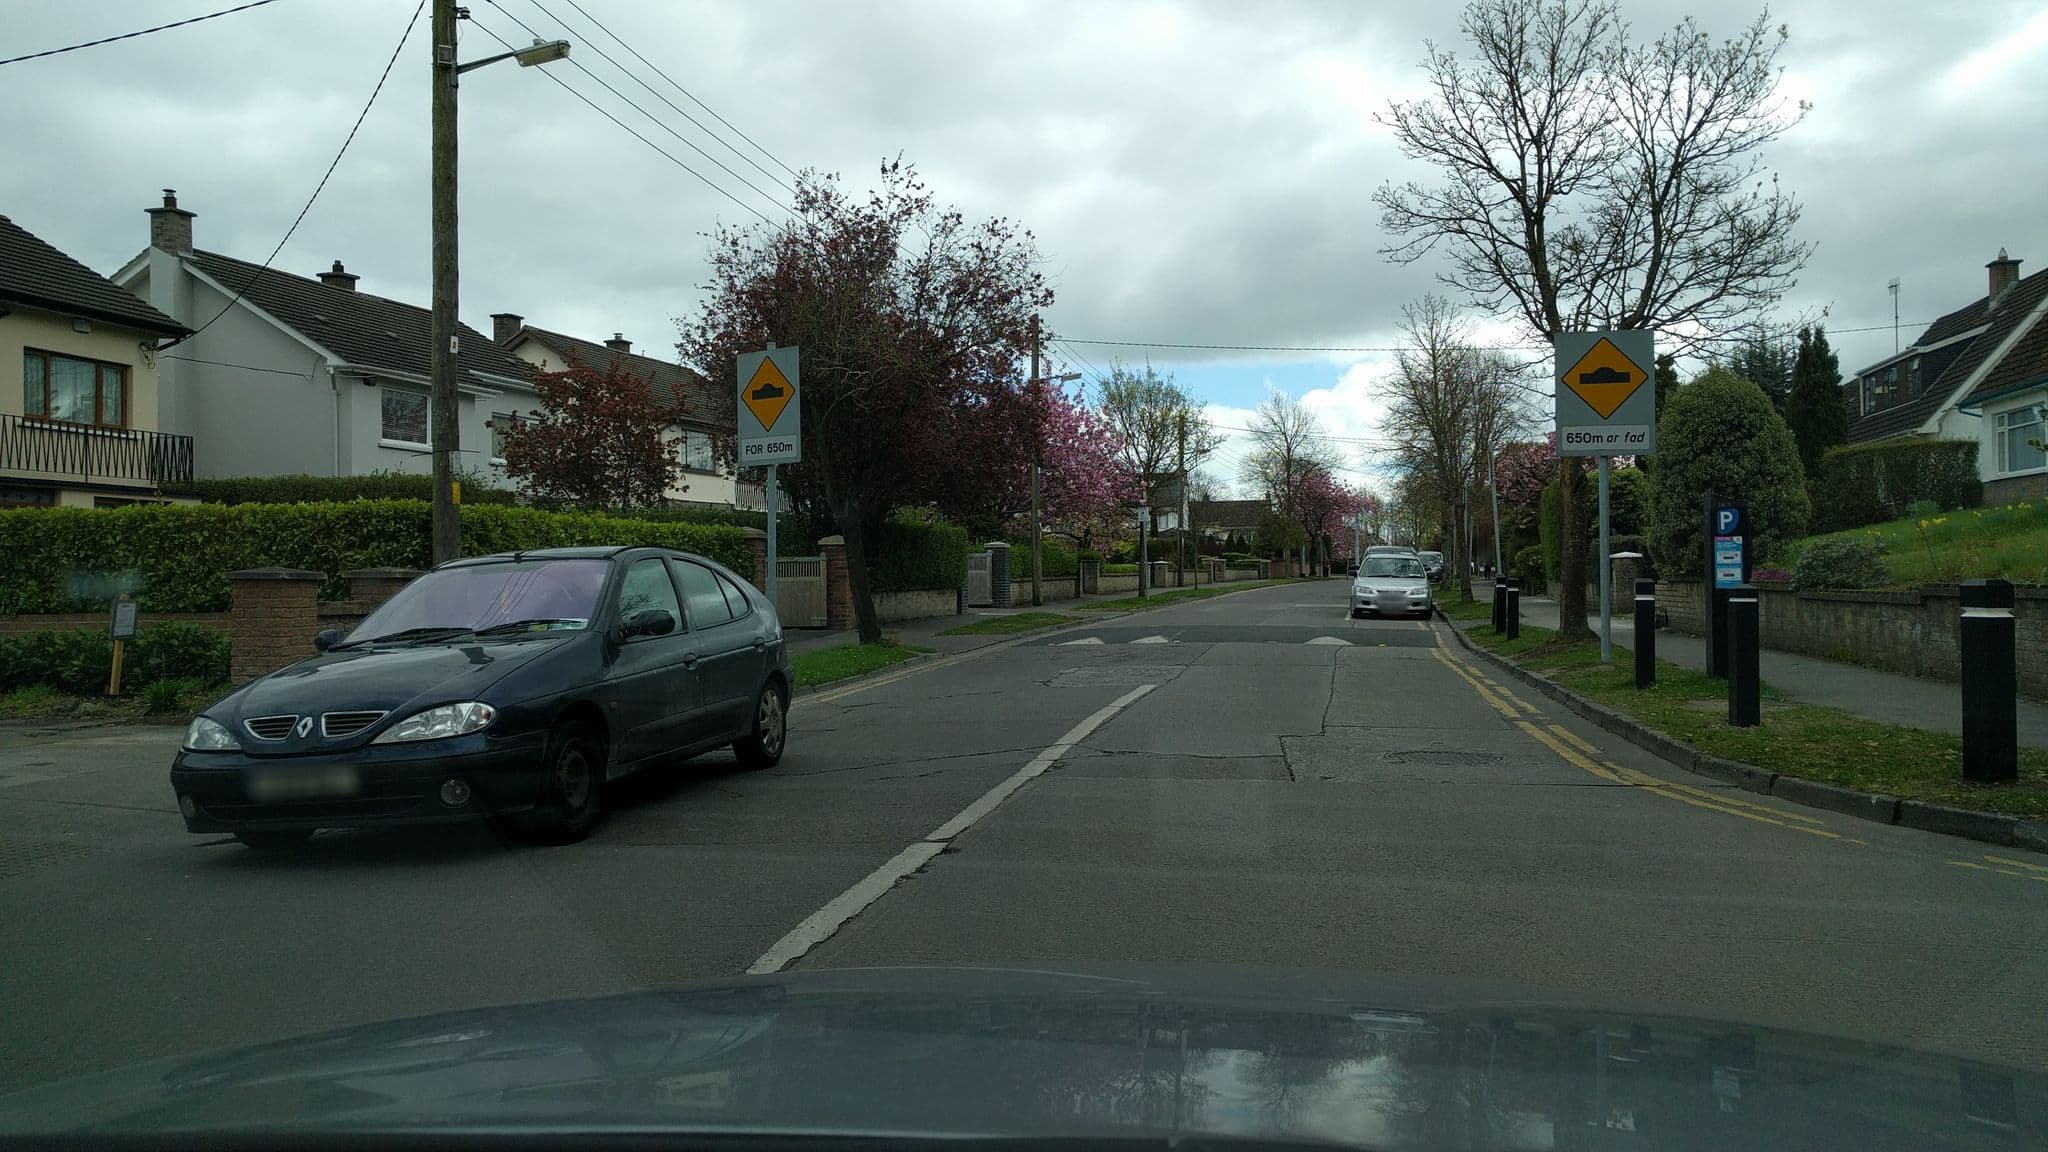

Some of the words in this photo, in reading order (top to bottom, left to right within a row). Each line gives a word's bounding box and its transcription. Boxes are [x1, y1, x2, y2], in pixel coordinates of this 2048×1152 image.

[1566, 432, 1603, 444] 650m
[1606, 435, 1620, 443] ar
[1624, 431, 1646, 443] fad
[745, 444, 763, 455] FOR
[767, 442, 793, 453] 650m
[1720, 511, 1733, 530] P
